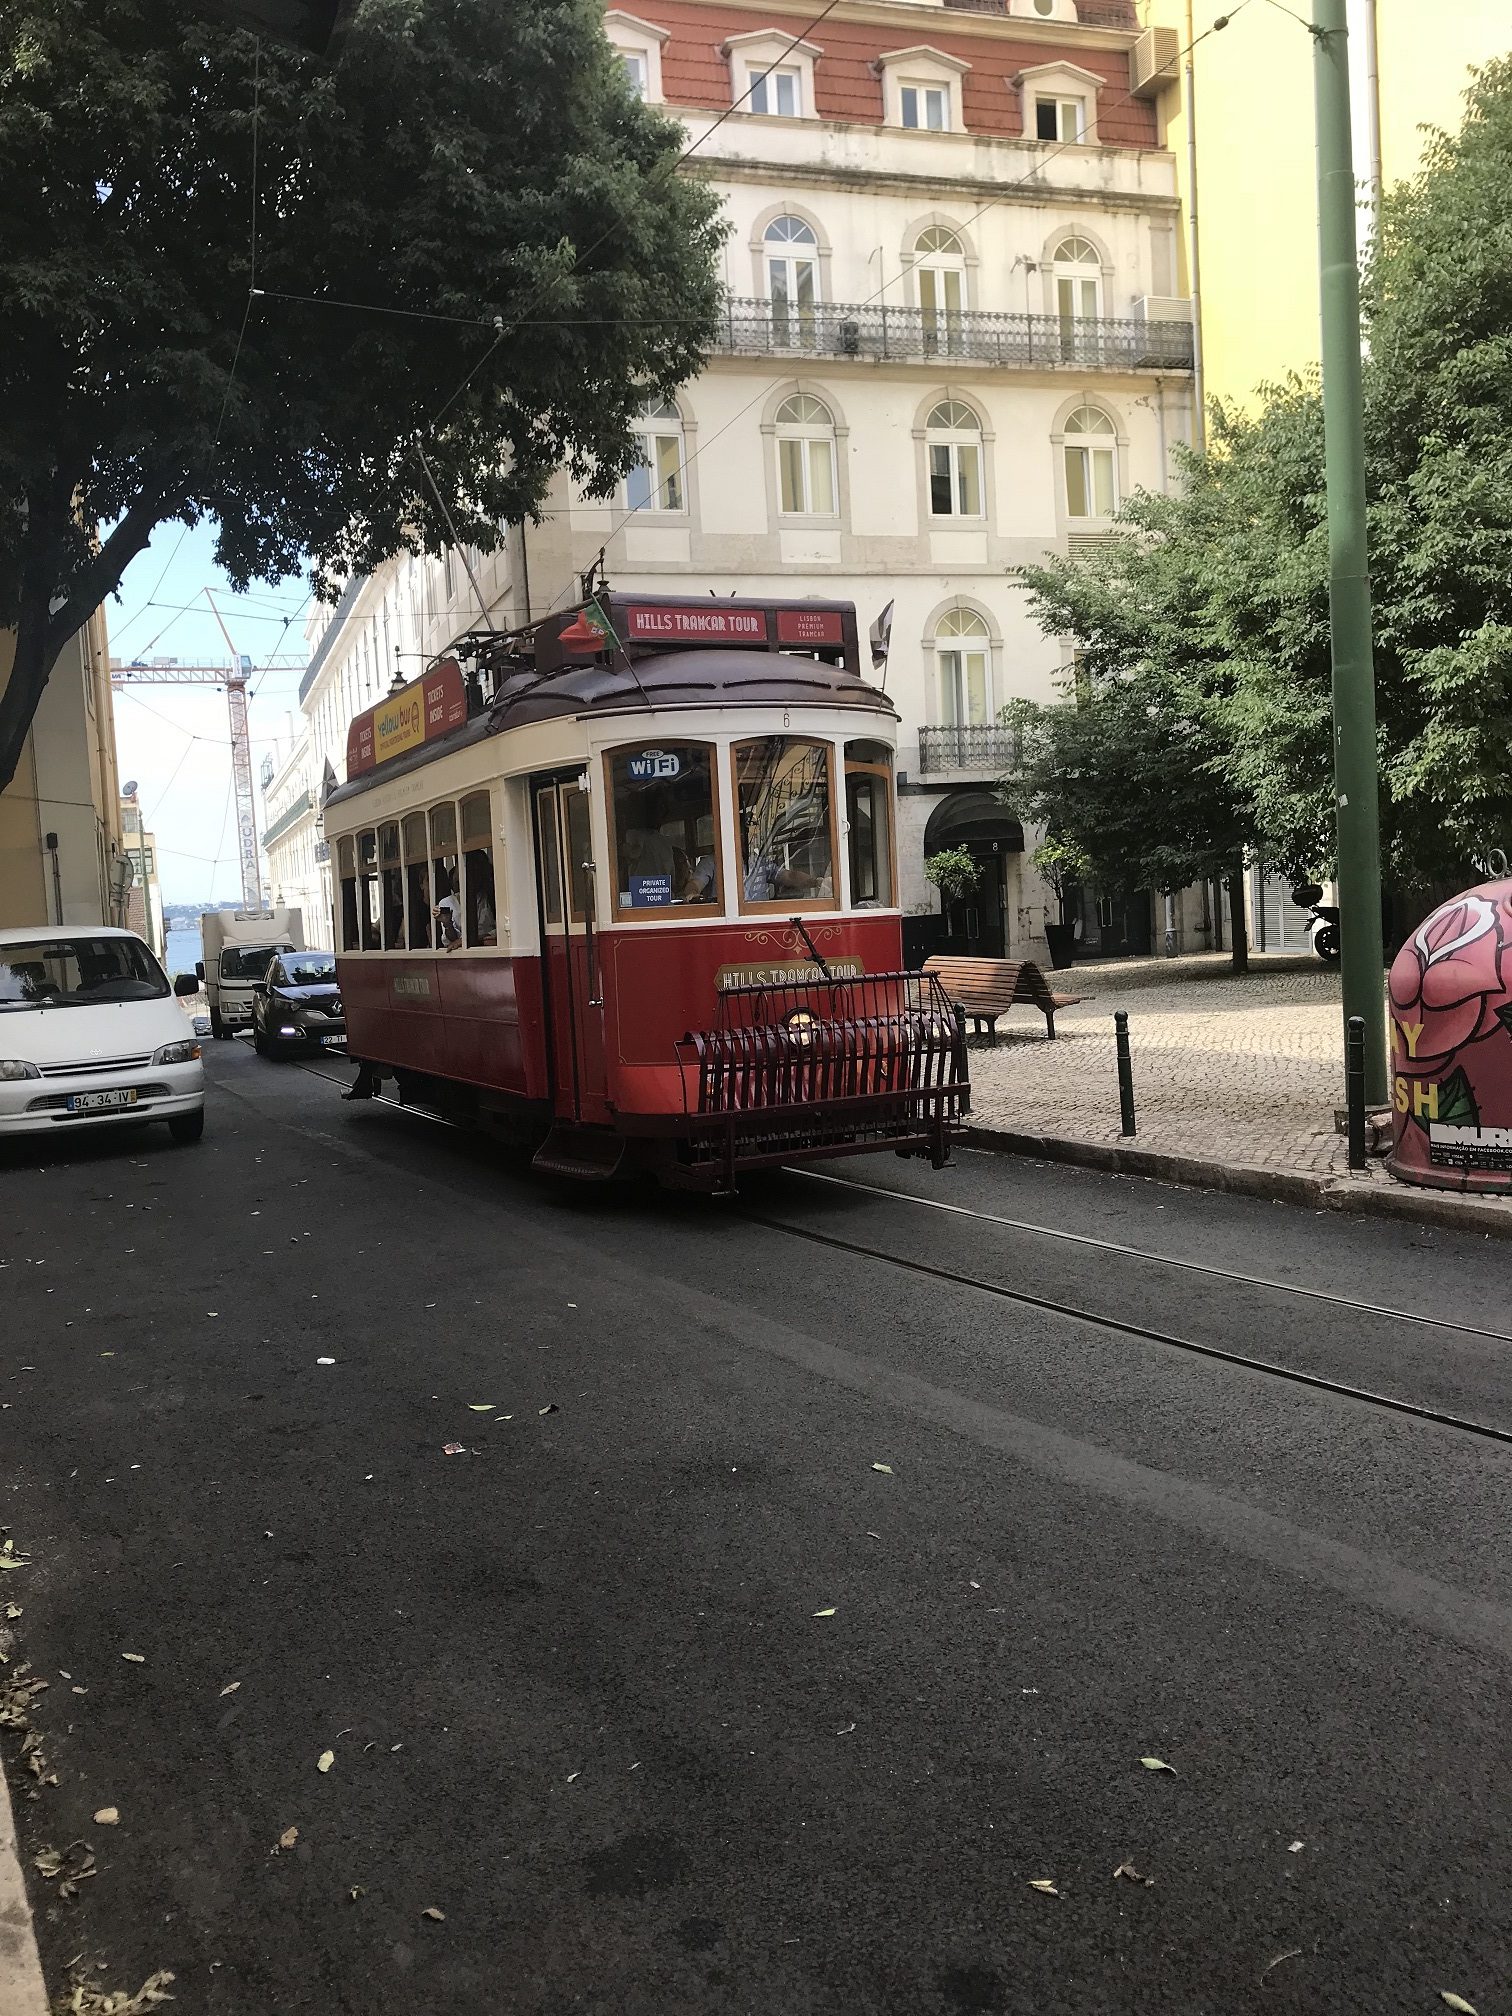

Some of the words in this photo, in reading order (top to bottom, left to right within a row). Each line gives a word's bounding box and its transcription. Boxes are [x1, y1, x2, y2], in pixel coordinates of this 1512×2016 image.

[636, 613, 673, 630] HILLS
[675, 614, 726, 631] TRAMCAR
[728, 616, 758, 632] TOUR
[427, 684, 444, 705] TICKETS
[783, 712, 790, 728] 6
[992, 842, 999, 852] 8
[642, 879, 666, 887] PRIVATE
